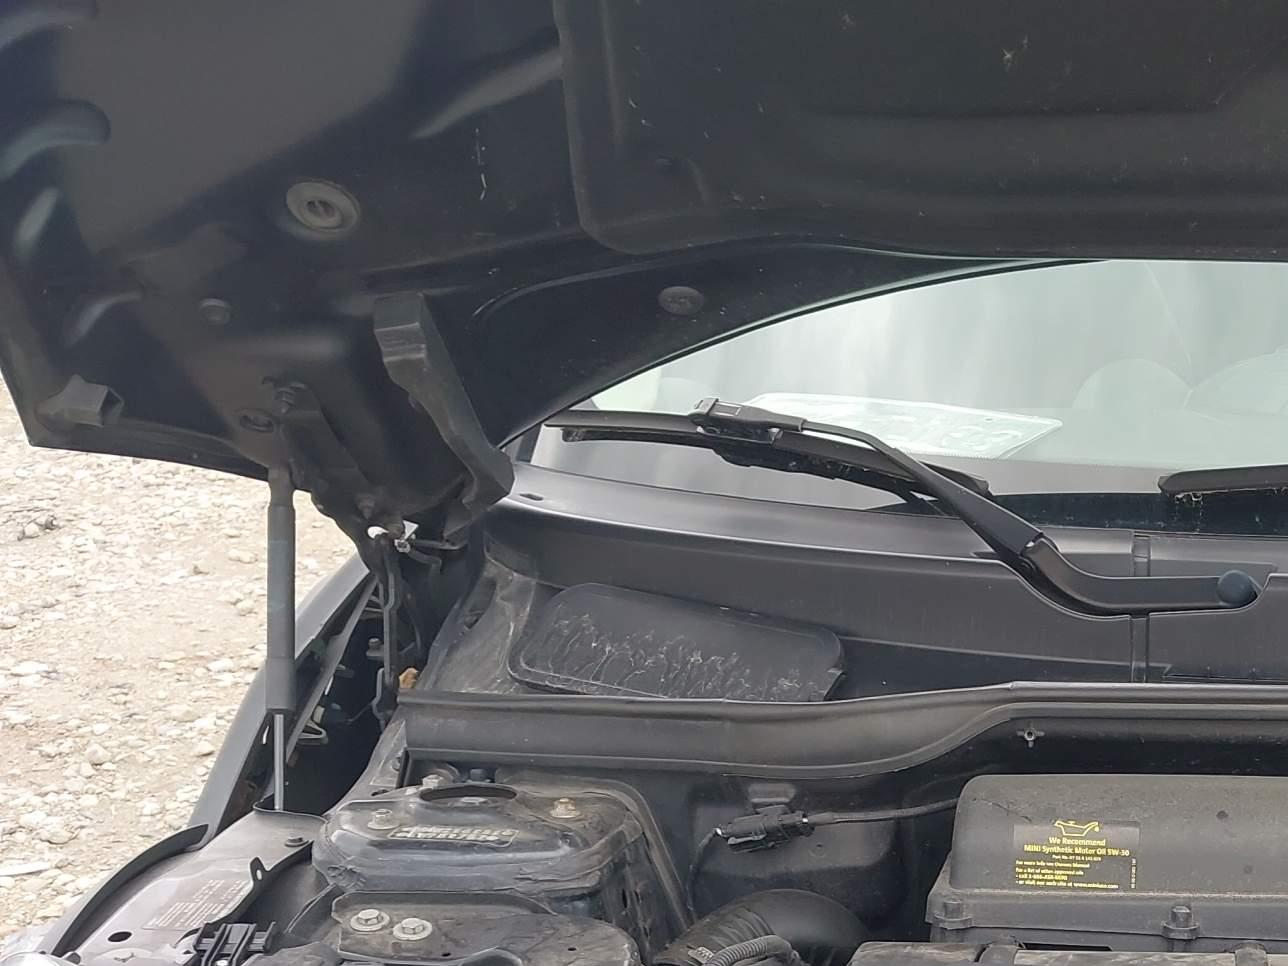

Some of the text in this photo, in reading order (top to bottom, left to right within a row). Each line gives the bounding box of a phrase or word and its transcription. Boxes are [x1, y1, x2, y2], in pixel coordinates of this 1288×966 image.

[1049, 836, 1106, 846] We Recommend
[1024, 844, 1041, 852] MINI
[1042, 845, 1073, 854] Synthetic
[1107, 848, 1130, 856] 5W-30
